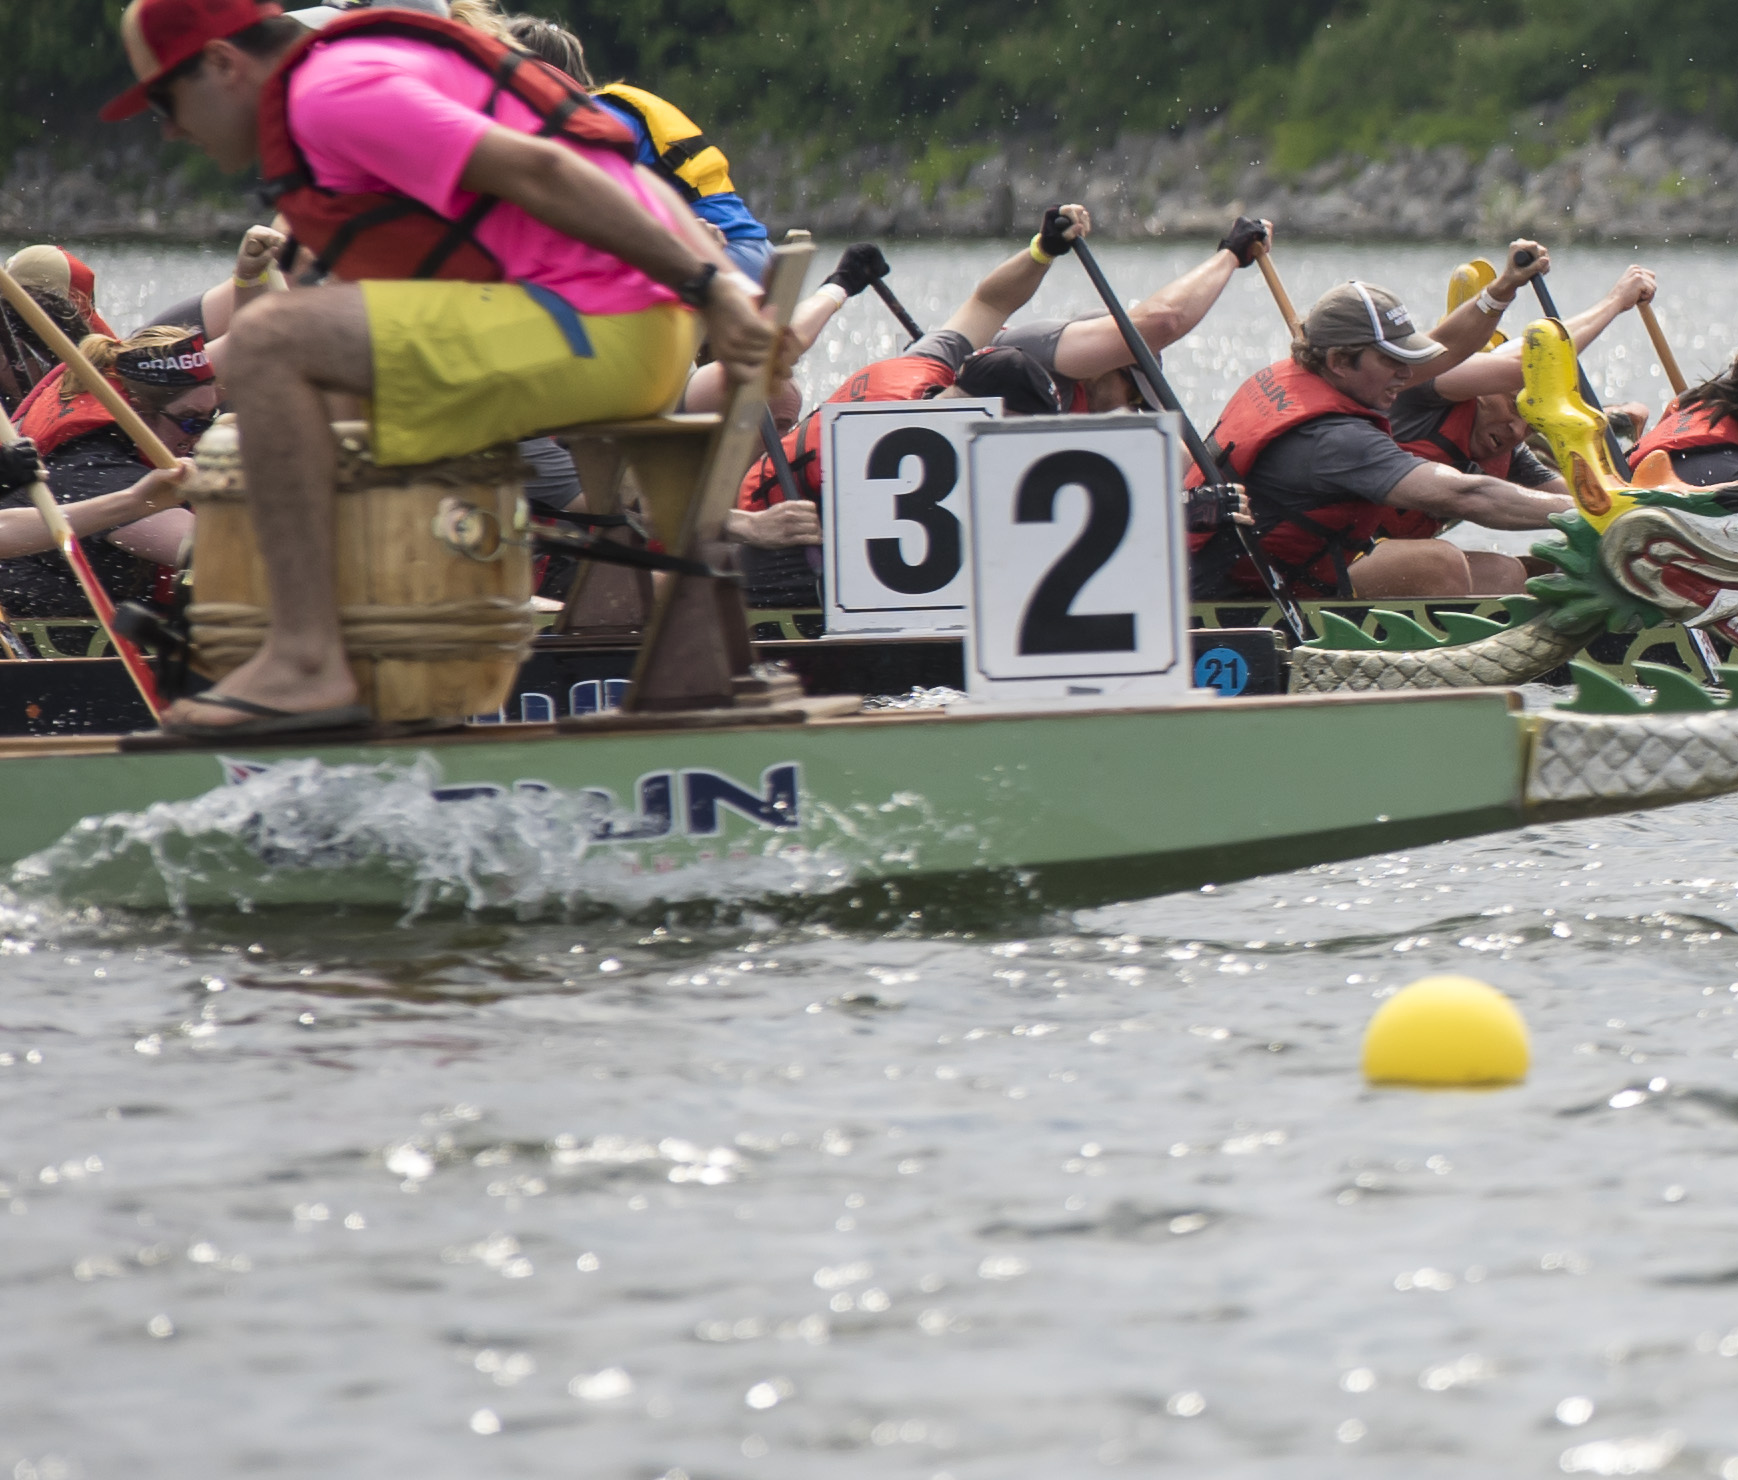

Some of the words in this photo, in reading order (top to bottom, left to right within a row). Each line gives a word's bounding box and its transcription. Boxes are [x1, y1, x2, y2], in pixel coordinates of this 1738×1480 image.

[137, 350, 210, 370] DRAGO
[864, 426, 964, 595] 3
[1013, 449, 1137, 656] 2
[1204, 657, 1238, 690] 21
